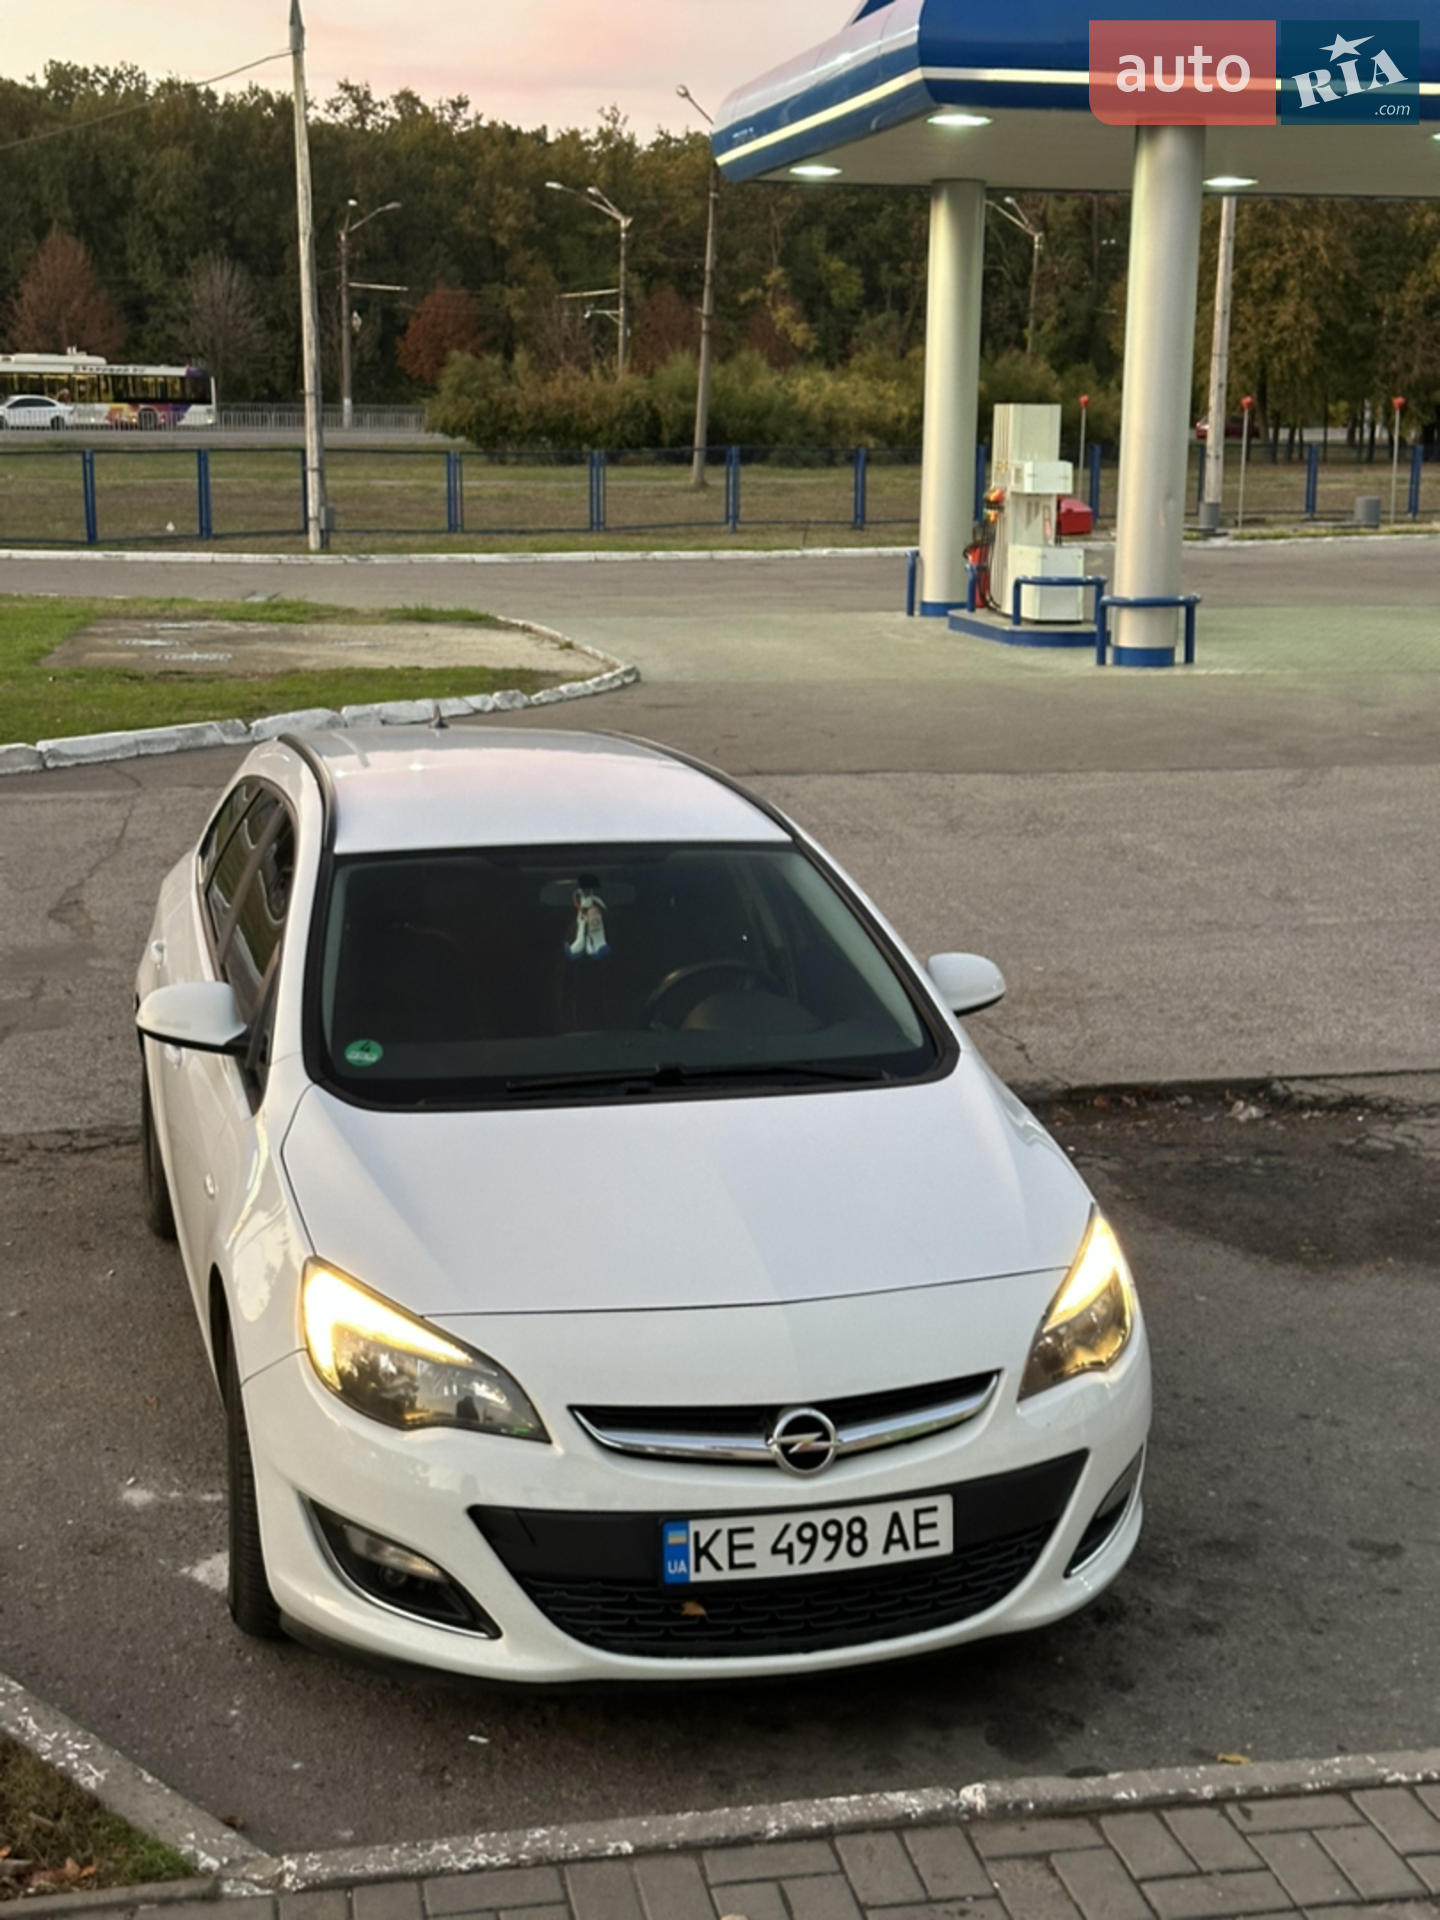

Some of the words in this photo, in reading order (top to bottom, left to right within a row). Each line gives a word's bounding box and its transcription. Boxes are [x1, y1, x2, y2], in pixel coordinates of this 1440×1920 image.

[693, 1526, 757, 1574] KE
[770, 1515, 868, 1566] 4998
[882, 1505, 941, 1555] AE
[667, 1559, 688, 1574] UA
